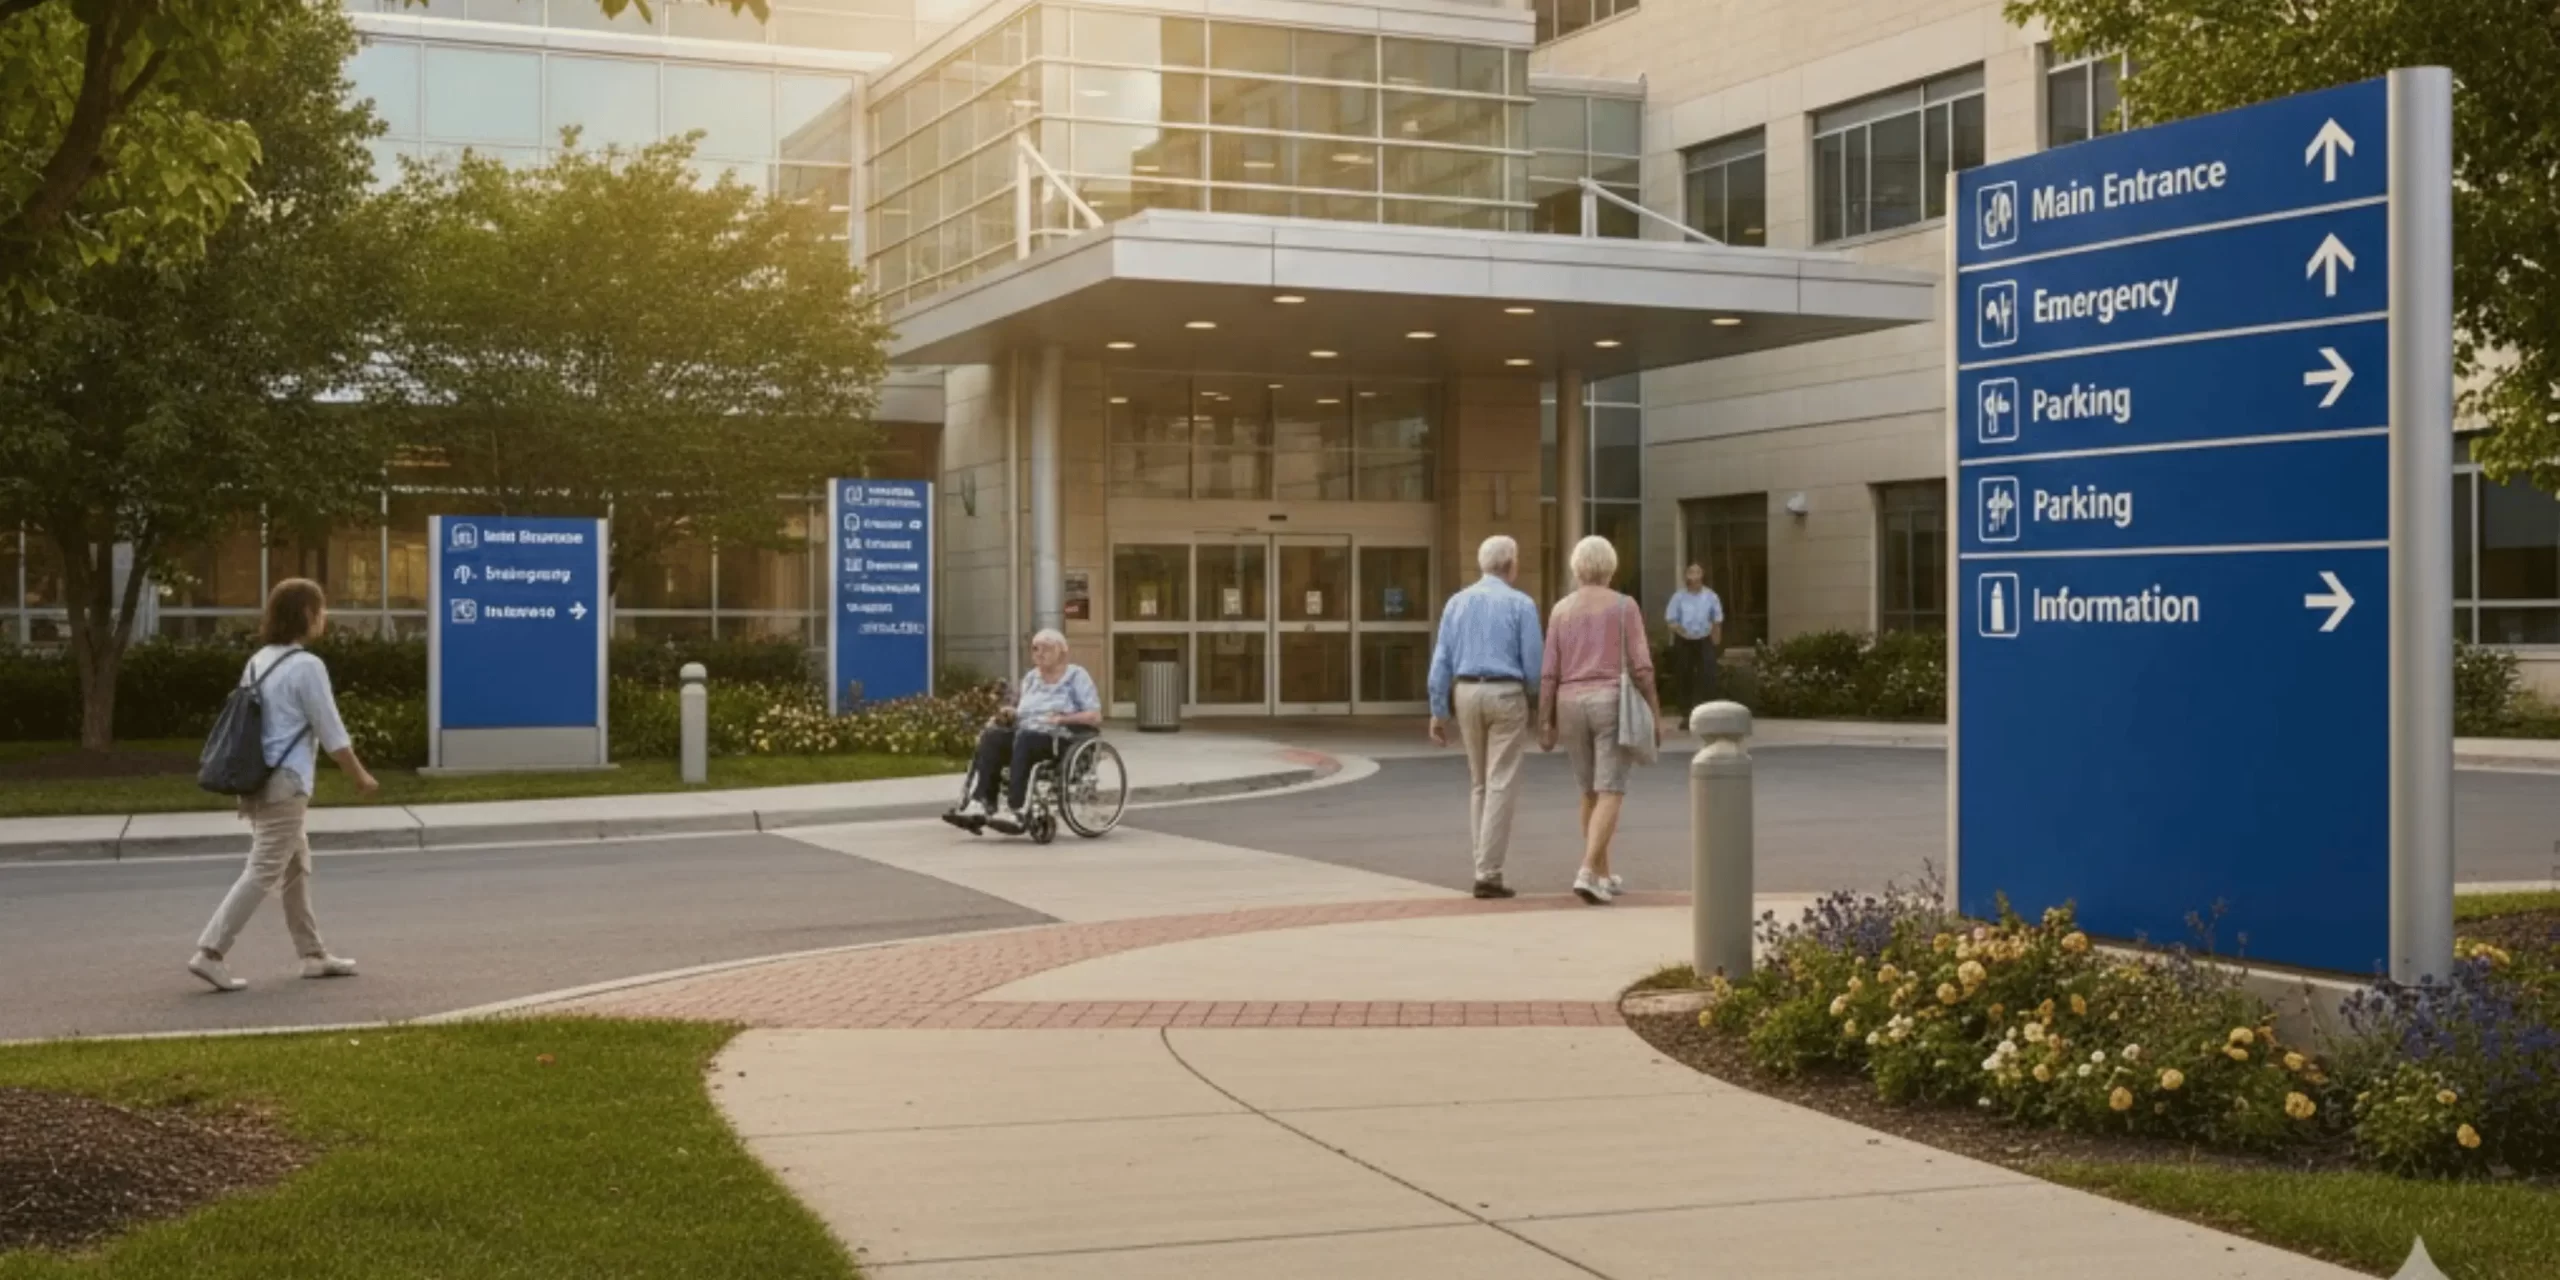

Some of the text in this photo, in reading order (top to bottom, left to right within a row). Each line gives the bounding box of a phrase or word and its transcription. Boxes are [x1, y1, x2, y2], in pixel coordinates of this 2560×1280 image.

[2032, 161, 2227, 222] Main Entrance
[2033, 277, 2179, 324] Emergency
[2032, 384, 2131, 424] Parking
[2033, 486, 2132, 528] Parking
[2033, 584, 2199, 623] Information
